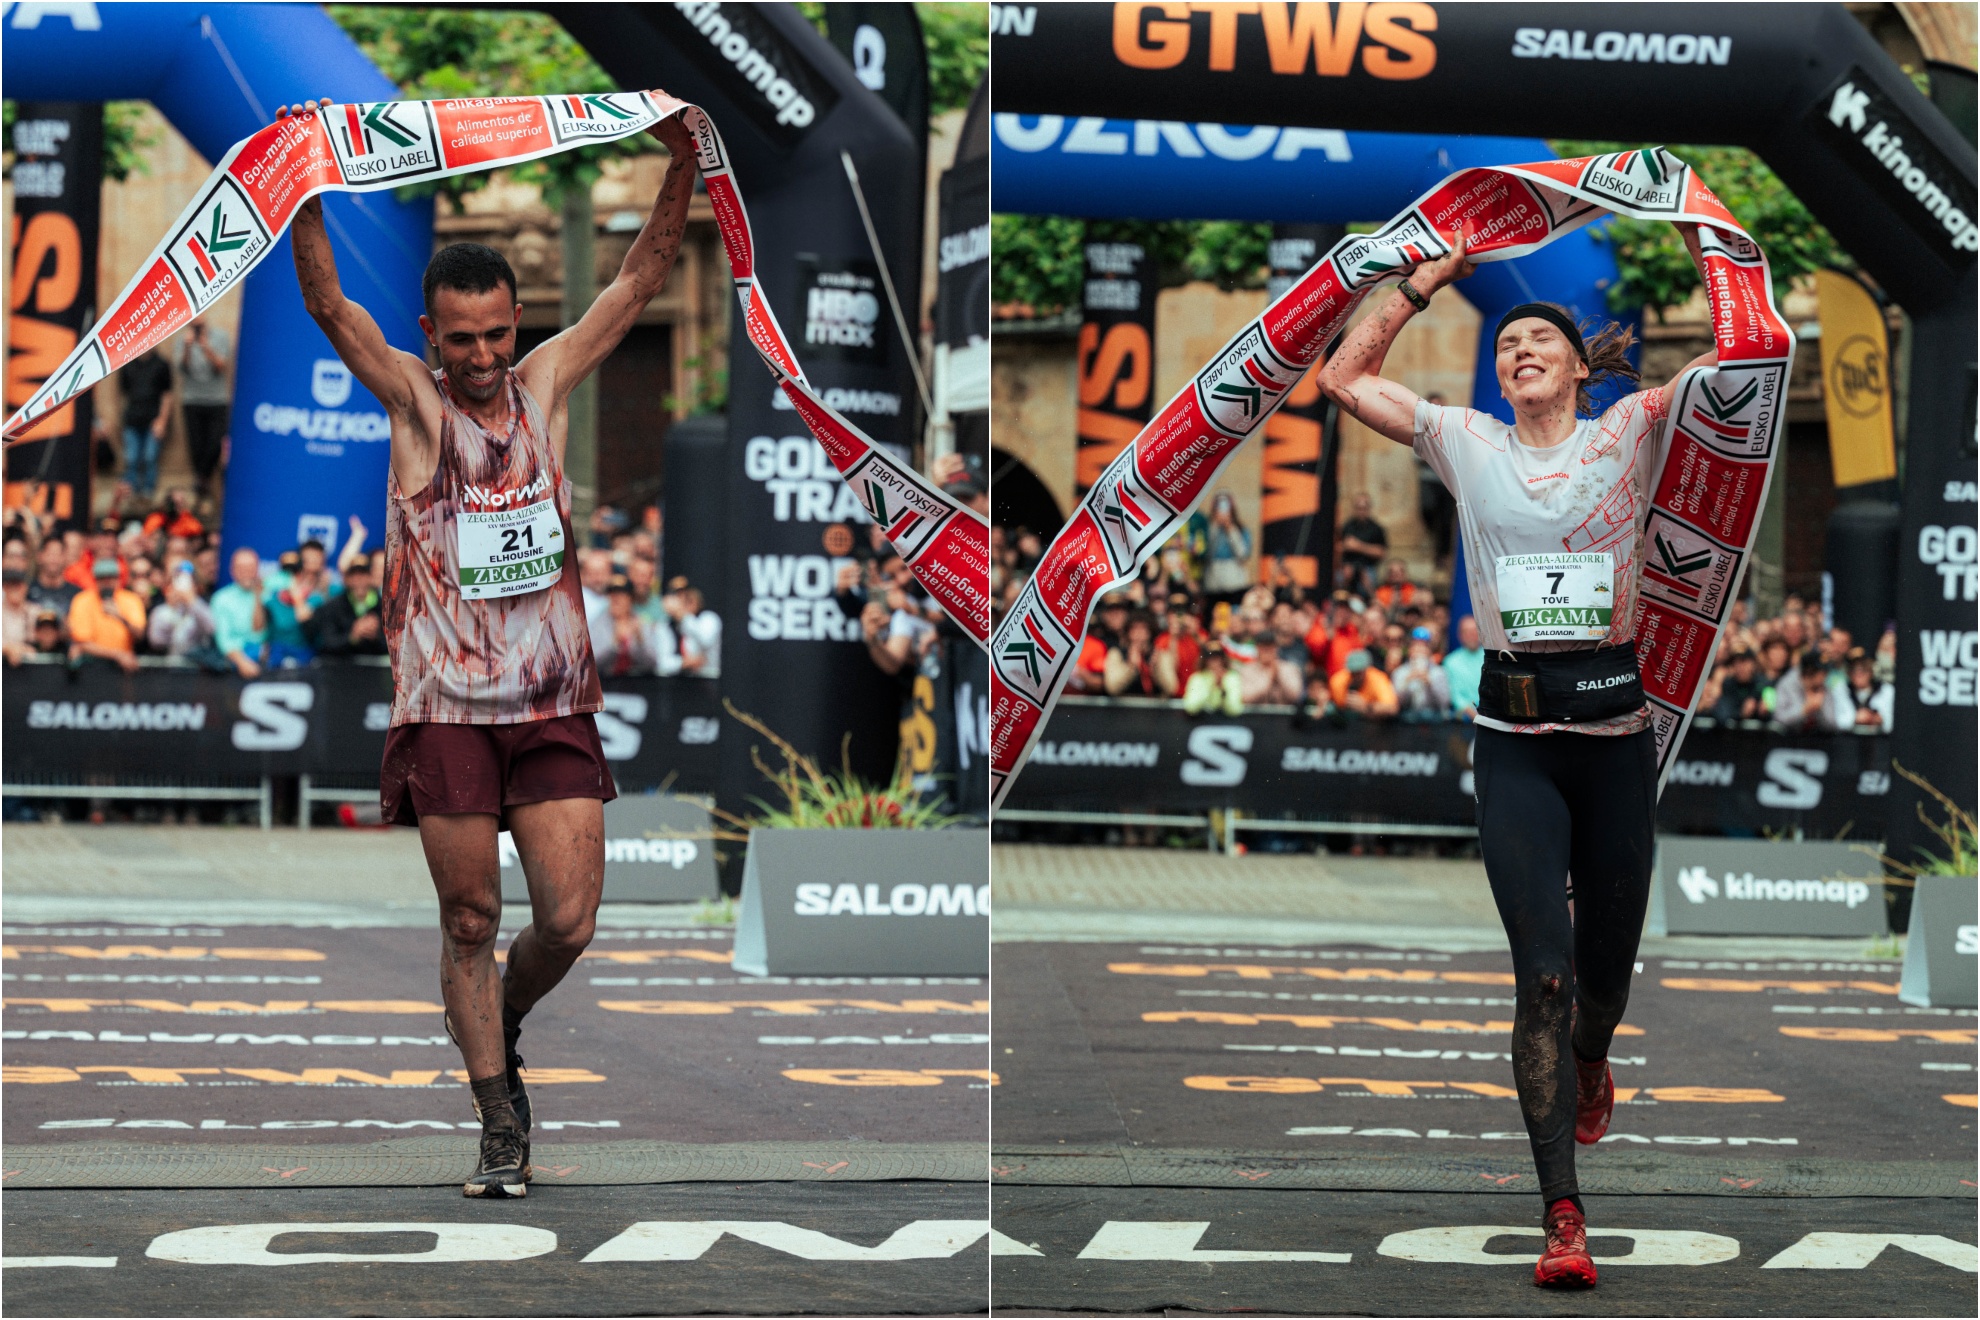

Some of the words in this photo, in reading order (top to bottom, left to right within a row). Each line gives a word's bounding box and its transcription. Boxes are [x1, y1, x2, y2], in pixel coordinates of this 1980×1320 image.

[1111, 2, 1439, 81] GTWS
[1512, 27, 1732, 67] SALOMON
[451, 130, 493, 149] calidad
[496, 124, 544, 142] superior
[456, 115, 516, 133] Alimentos
[517, 112, 533, 124] de
[562, 121, 607, 134] EUSKO
[610, 115, 650, 132] LABEL
[242, 112, 313, 186] Goi-mailako
[257, 125, 314, 190] elikagaiak
[697, 118, 716, 164] EUSKO
[268, 153, 308, 203] Alimentos
[308, 145, 324, 159] de
[345, 158, 387, 177] EUSKO
[391, 150, 433, 169] LABEL
[269, 181, 295, 218] calidad
[294, 159, 334, 183] superior
[1473, 171, 1505, 195] calidad
[1591, 171, 1633, 196] EUSKO
[1635, 187, 1674, 204] LABEL
[1862, 119, 1978, 253] kinomap
[713, 181, 738, 225] superior
[1435, 189, 1474, 224] superior
[1463, 185, 1509, 220] Alimentos
[716, 206, 742, 261] Alimentos
[1449, 217, 1463, 231] de
[200, 268, 233, 304] EUSKO
[234, 236, 264, 271] LABEL
[1340, 240, 1378, 267] LABEL
[807, 286, 880, 325] HBO
[1303, 279, 1333, 309] calidad
[1712, 267, 1736, 348] elikagaiak
[1740, 270, 1761, 311] superior
[105, 273, 172, 348] Goi-mailako
[116, 289, 173, 352] elikagaiak
[1271, 304, 1303, 336] superior
[1293, 294, 1336, 333] Alimentos
[1741, 288, 1759, 343] Alimentos
[123, 319, 167, 361] Alimentos
[167, 307, 178, 320] de
[1281, 330, 1294, 343] de
[1755, 312, 1773, 350] calidad
[1229, 333, 1259, 366] EUSKO
[1202, 362, 1229, 390] LABEL
[771, 385, 902, 416] SLOMON
[1166, 401, 1193, 432] calidad
[1751, 411, 1770, 452] EUSKO
[1765, 368, 1777, 407] LABEL
[817, 425, 851, 457] calidad
[1138, 423, 1167, 456] superior
[1156, 416, 1193, 454] Alimentos
[1108, 455, 1130, 488] EUSKO
[1145, 450, 1155, 462] de
[1154, 434, 1210, 484] elikagaiak
[1162, 437, 1229, 498] Goi-mailako
[868, 461, 905, 493] LABEL
[1527, 472, 1570, 484] SALOMON
[1668, 442, 1699, 512] Goi-mailako
[1688, 457, 1711, 515] elikagaiak
[467, 500, 551, 524] ZEGAMA-AIZKORRI
[904, 488, 944, 519] EUSKO
[1708, 482, 1730, 525] Alimentos
[1725, 470, 1734, 482] de
[1721, 505, 1739, 537] calidad
[1735, 466, 1750, 505] superior
[489, 546, 544, 563] ELHOUSINE
[501, 524, 534, 553] 21
[947, 541, 961, 555] de
[1063, 527, 1091, 556] calidad
[473, 556, 558, 584] ZEGAMA
[1040, 551, 1063, 587] superior
[1053, 540, 1088, 580] Alimentos
[1505, 554, 1605, 567] ZEGAMA-AIZKORRI
[500, 581, 538, 593] SALOMON
[1046, 578, 1056, 591] de
[1056, 555, 1097, 610] elikagaiak
[1063, 562, 1108, 627] Goi-mailako
[1546, 572, 1565, 595] 7
[1701, 582, 1721, 615] EUSKO
[1715, 553, 1733, 584] LABEL
[1013, 590, 1034, 626] EUSKO
[1541, 596, 1570, 605] TOVE
[1511, 609, 1601, 627] ZEGAMA
[995, 624, 1014, 653] LABEL
[1639, 612, 1662, 674] ikagaiak
[1654, 637, 1679, 684] Alimentos
[1674, 623, 1684, 637] de
[1666, 660, 1686, 696] calidad
[1682, 622, 1699, 661] superior
[1576, 670, 1638, 691] SALOMON
[27, 701, 206, 731] SALOMON
[1656, 713, 1675, 747] LABEL
[1281, 746, 1440, 777] SALOMON
[795, 883, 988, 917] SALOM
[1724, 871, 1869, 909] kinomap
[38, 1117, 621, 1131] SALOMN
